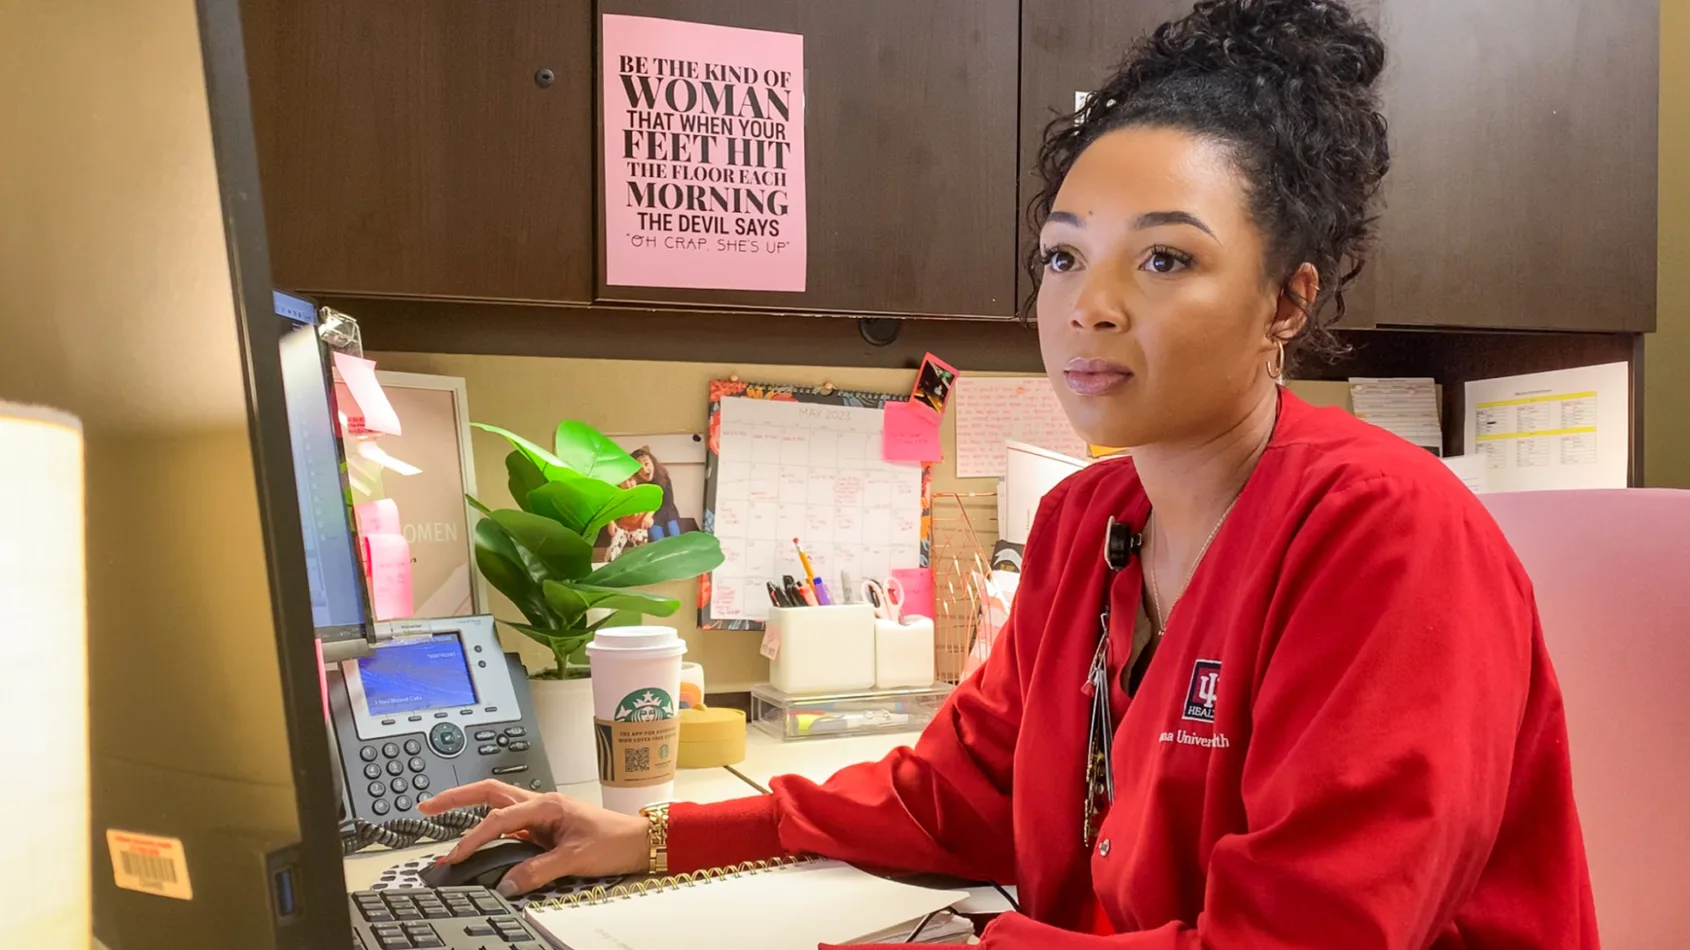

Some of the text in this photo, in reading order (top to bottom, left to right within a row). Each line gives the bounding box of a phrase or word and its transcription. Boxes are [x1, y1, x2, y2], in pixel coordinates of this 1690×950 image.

[619, 55, 791, 88] BE THE KIND OF
[619, 74, 791, 122] WOMAN
[627, 110, 786, 140] THAT WHEN YOUR
[622, 129, 791, 169] FEET HIT
[627, 162, 786, 187] THE FLOOR EACH
[626, 181, 789, 216] MORNING
[637, 212, 779, 237] THE DEVIL SAYS
[717, 239, 759, 253] SHE'S
[800, 408, 851, 421] MAY 2023
[403, 522, 458, 543] OMEN
[1187, 705, 1215, 718] HEAL
